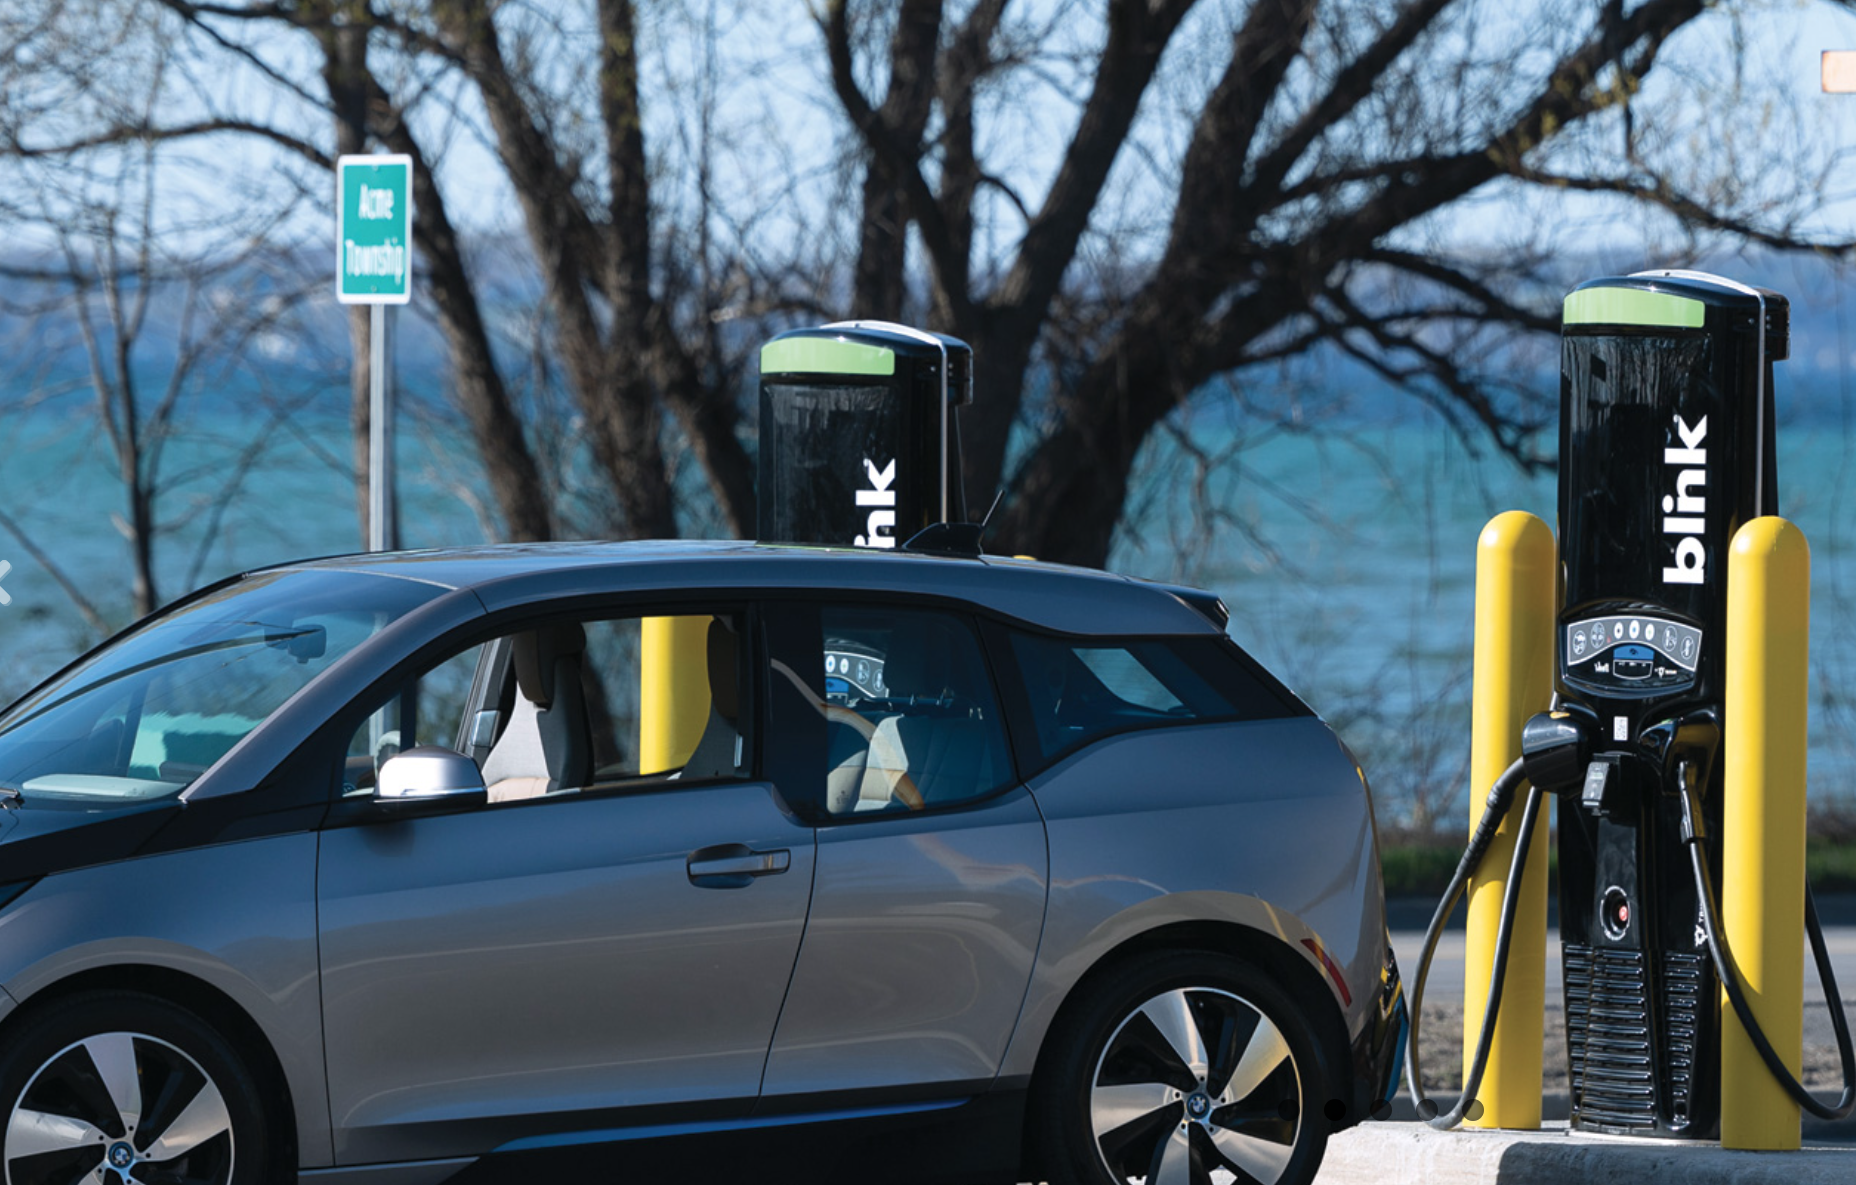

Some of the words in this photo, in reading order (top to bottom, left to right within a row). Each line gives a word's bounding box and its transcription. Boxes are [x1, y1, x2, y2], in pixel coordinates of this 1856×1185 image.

[358, 183, 395, 220] Acme
[345, 238, 404, 286] Township
[853, 458, 896, 549] ink
[1662, 414, 1707, 585] blink
